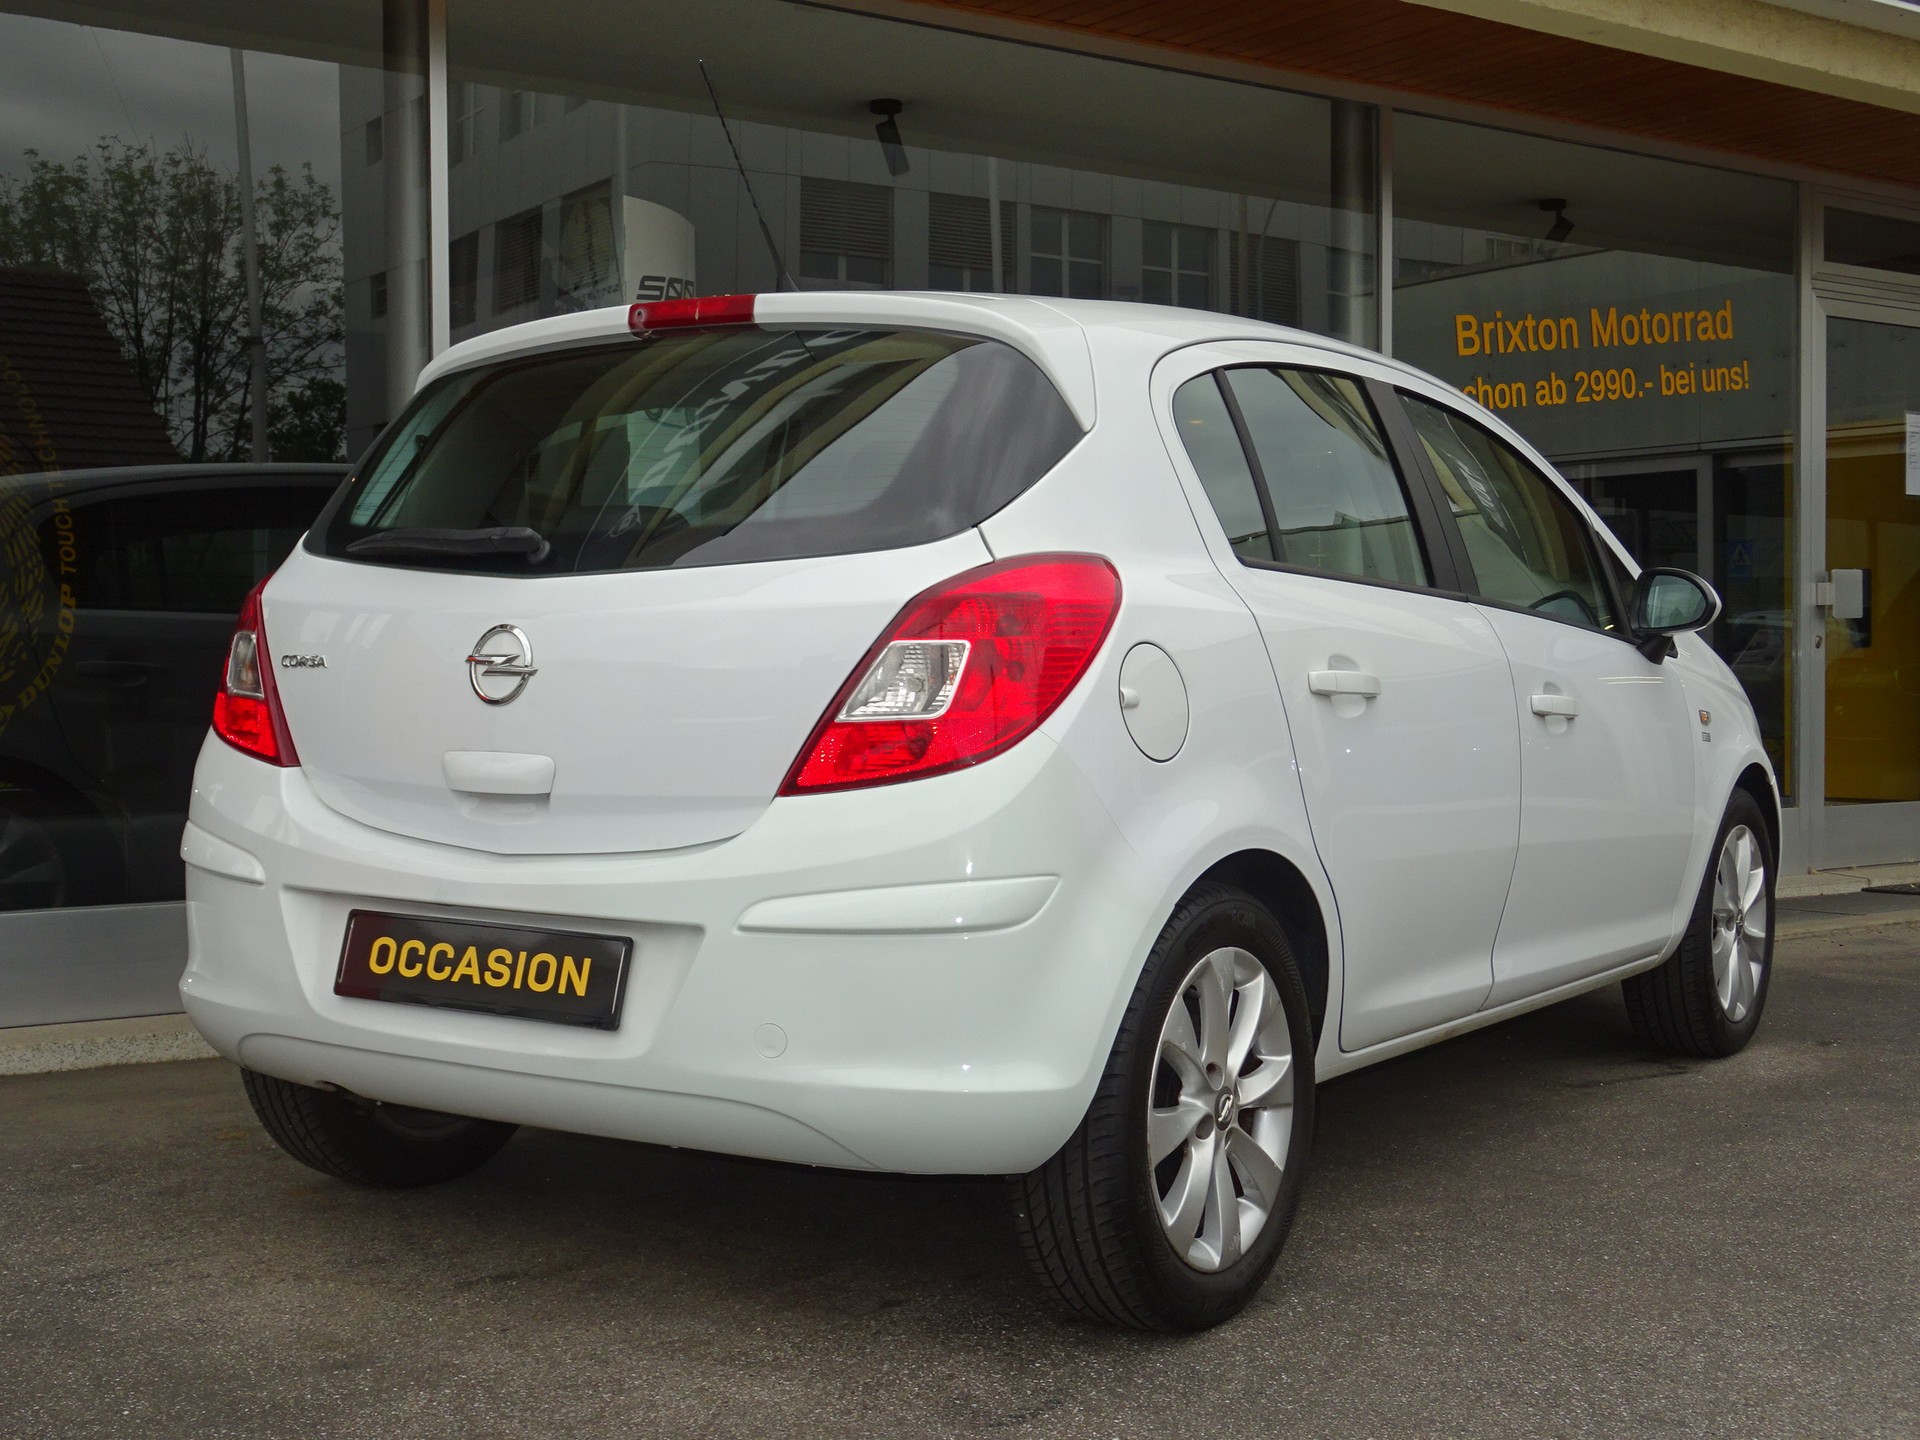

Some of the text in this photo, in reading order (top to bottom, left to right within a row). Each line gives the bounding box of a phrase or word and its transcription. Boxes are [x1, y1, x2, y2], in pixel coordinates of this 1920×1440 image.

[1455, 299, 1734, 356] Brixton Motorrad
[1456, 359, 1750, 410] hon ab 2990.- bei uns!
[18, 582, 83, 711] DUNLOP
[54, 498, 79, 576] TOUCH
[281, 655, 328, 669] CORSA
[368, 935, 592, 997] OCCASION
